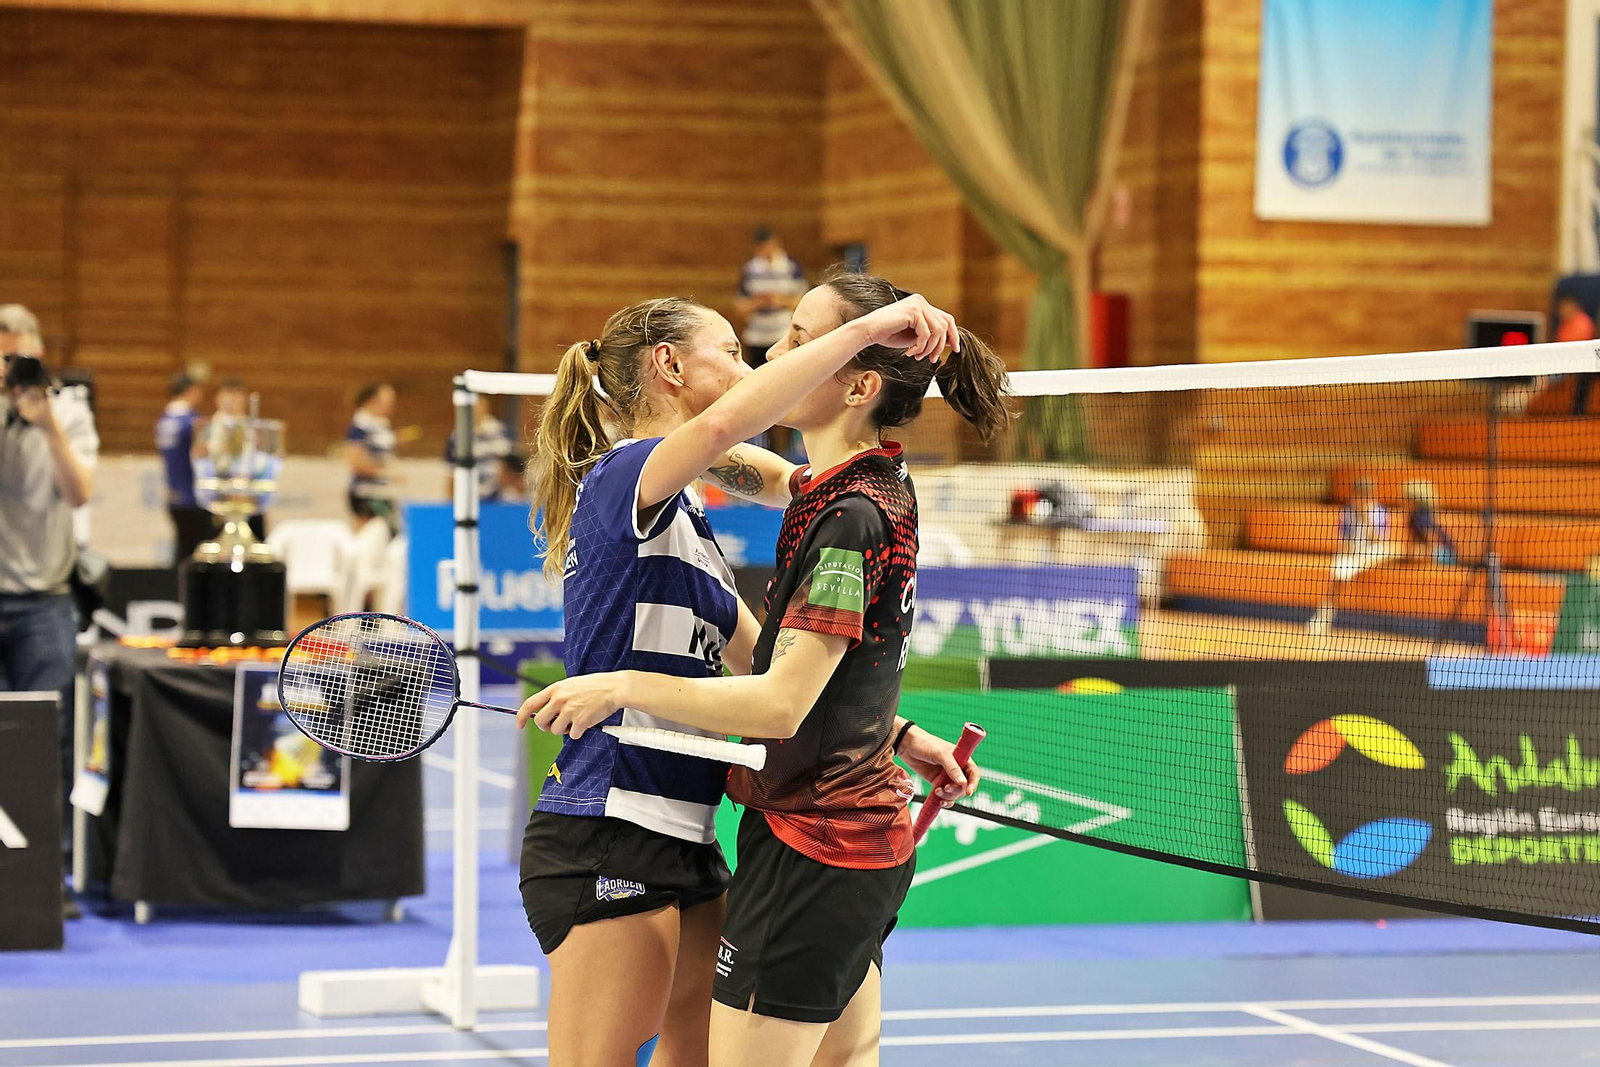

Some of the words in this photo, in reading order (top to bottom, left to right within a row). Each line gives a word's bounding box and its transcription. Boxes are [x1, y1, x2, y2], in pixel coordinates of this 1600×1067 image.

[818, 562, 863, 577] DIPUTACIO
[816, 582, 861, 597] SEVILLA
[967, 597, 1127, 657] YONEX
